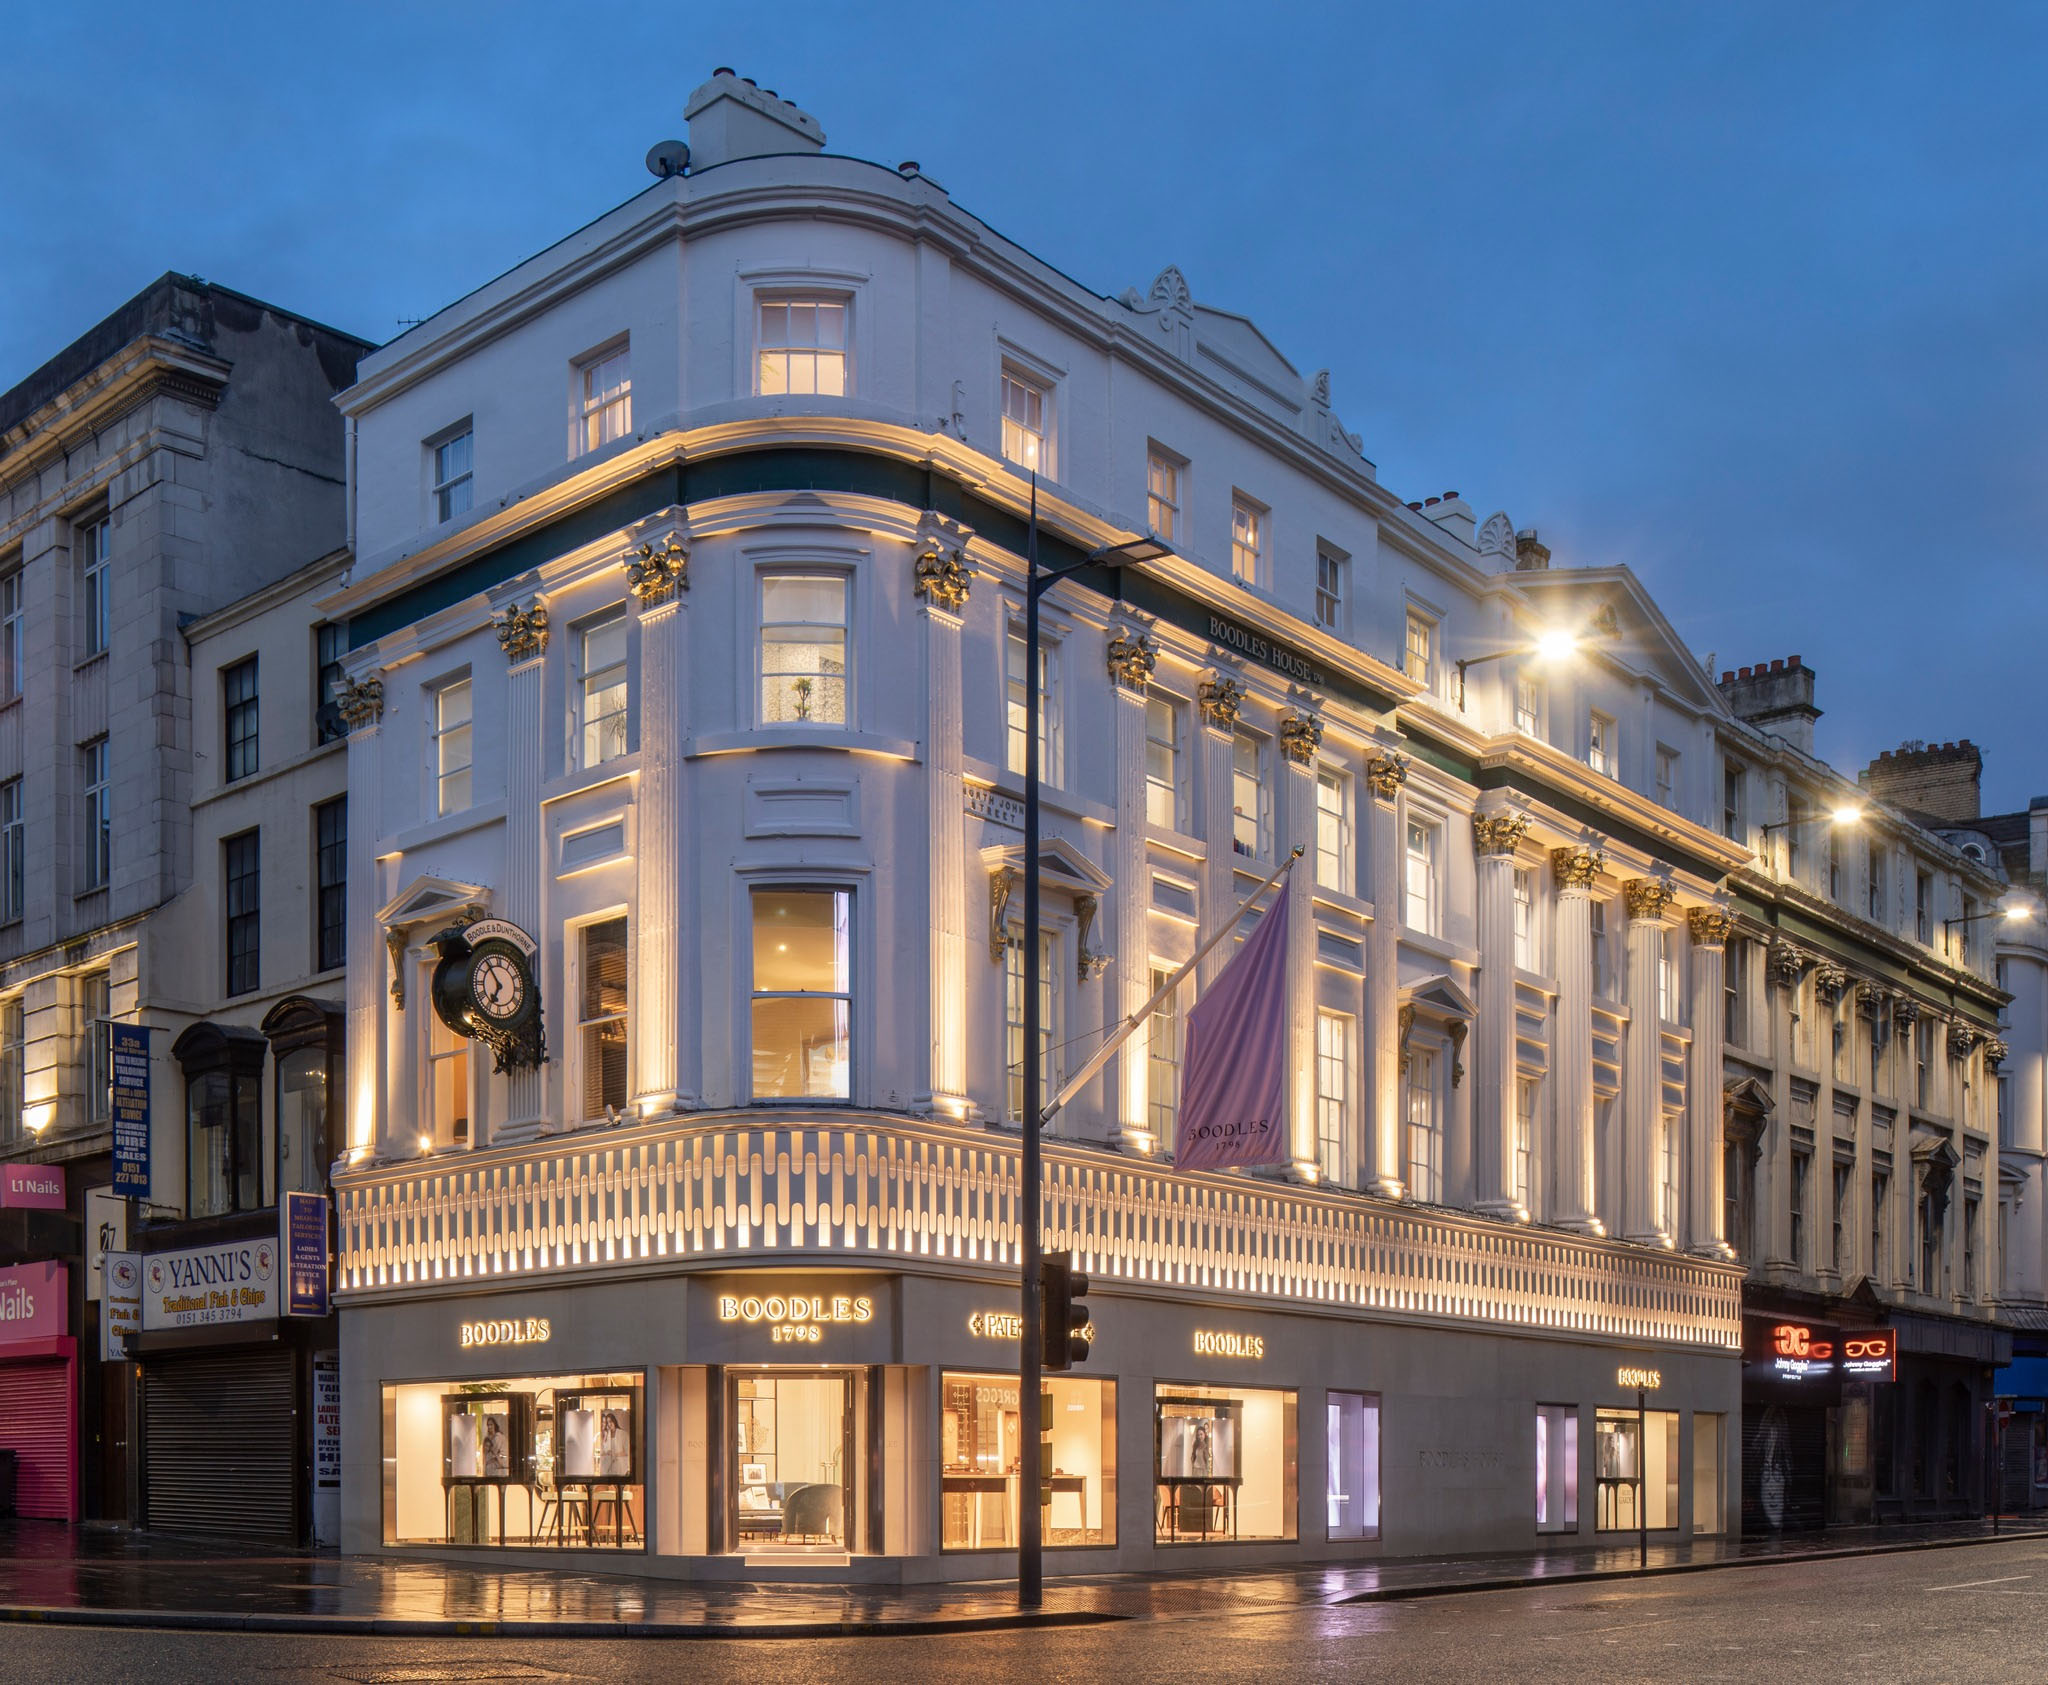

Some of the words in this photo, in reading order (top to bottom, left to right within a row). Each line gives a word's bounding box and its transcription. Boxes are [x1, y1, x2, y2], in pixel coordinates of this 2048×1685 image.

[1209, 616, 1267, 660] BOODLES
[1272, 647, 1311, 680] HOUSE
[963, 787, 994, 805] NORTH
[1000, 799, 1024, 815] JOHN
[971, 801, 1015, 823] STREET
[466, 924, 491, 942] BOODLE
[496, 923, 532, 951] DUNTHORNE
[116, 1065, 147, 1077] TAILORING
[119, 1075, 144, 1087] SERVICE
[115, 1135, 147, 1148] HIRE
[1215, 1141, 1240, 1151] 1798
[115, 1150, 147, 1161] SALES
[122, 1162, 140, 1174] 0151
[115, 1172, 129, 1183] 227
[12, 1179, 24, 1193] L1
[26, 1180, 60, 1194] Nails
[169, 1250, 251, 1288] YANNI'S
[162, 1291, 208, 1313] Traditional
[209, 1290, 229, 1309] Fish
[231, 1288, 238, 1307] &
[240, 1286, 266, 1308] Chips
[110, 1307, 130, 1320] Fish
[176, 1313, 196, 1325] 0151
[200, 1310, 216, 1322] 345
[219, 1308, 242, 1320] 3794
[720, 1296, 871, 1321] BOODLES
[460, 1318, 549, 1346] BOODLES
[773, 1326, 820, 1341] 1798
[1195, 1331, 1264, 1358] BOODLES
[1618, 1368, 1660, 1388] BOODLES
